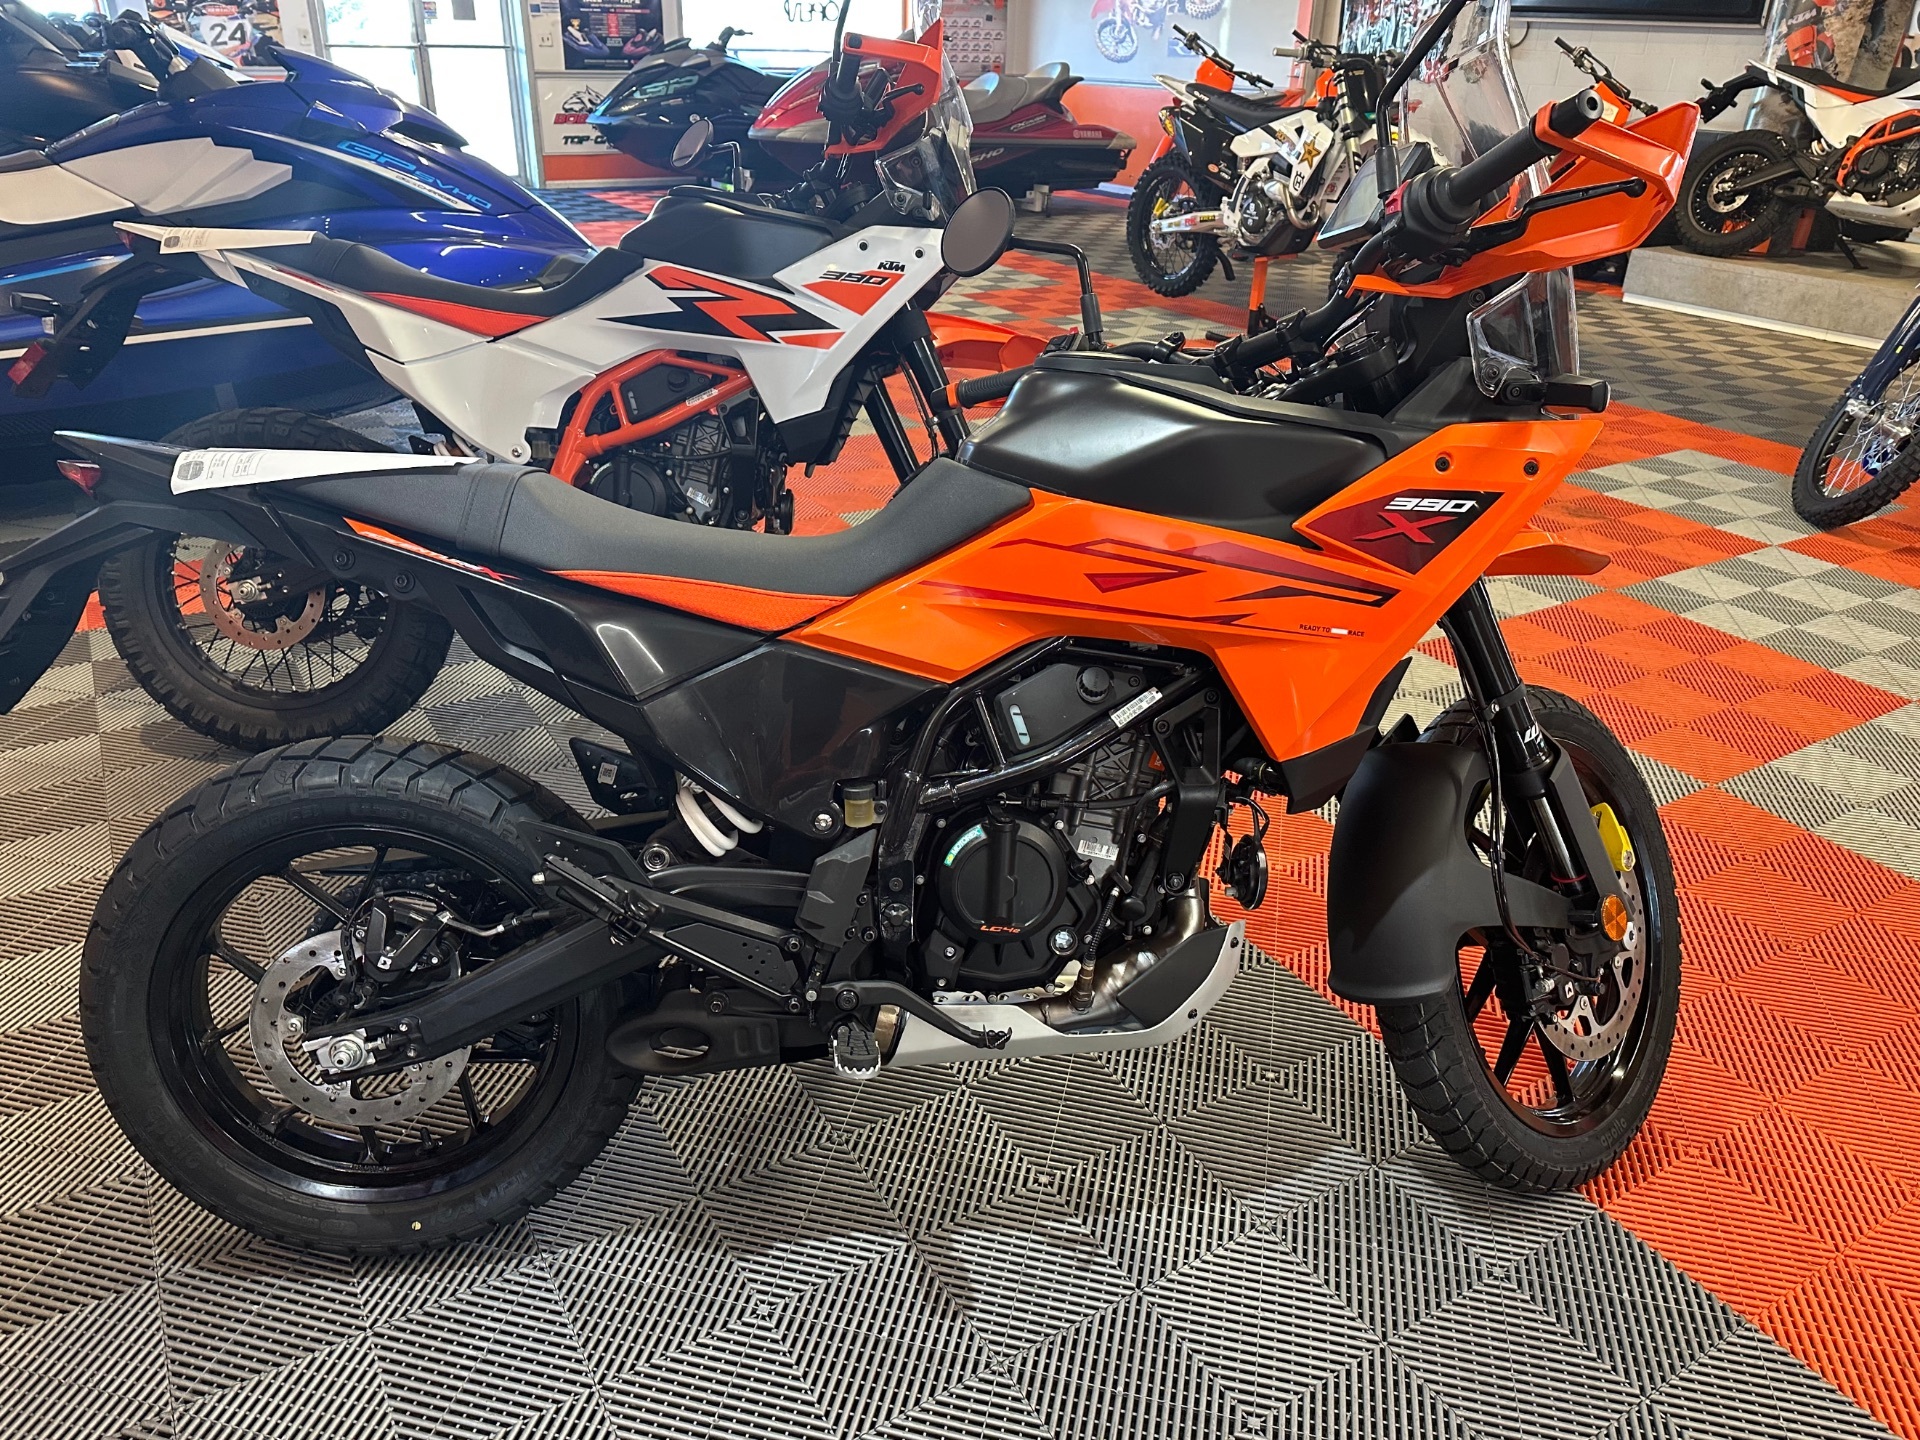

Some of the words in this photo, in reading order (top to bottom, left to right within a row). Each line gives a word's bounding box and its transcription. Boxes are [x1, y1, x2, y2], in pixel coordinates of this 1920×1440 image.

[1787, 8, 1816, 26] KTM
[209, 22, 246, 47] 24
[633, 75, 699, 98] GP
[1079, 130, 1102, 138] YAMAHA
[337, 140, 417, 172] GP
[413, 171, 492, 209] SVHO
[877, 260, 906, 272] KTM
[819, 270, 890, 286] 390
[1383, 497, 1477, 513] 390
[1352, 511, 1459, 544] X
[1299, 624, 1321, 632] READY
[951, 828, 980, 855] MOTOREX
